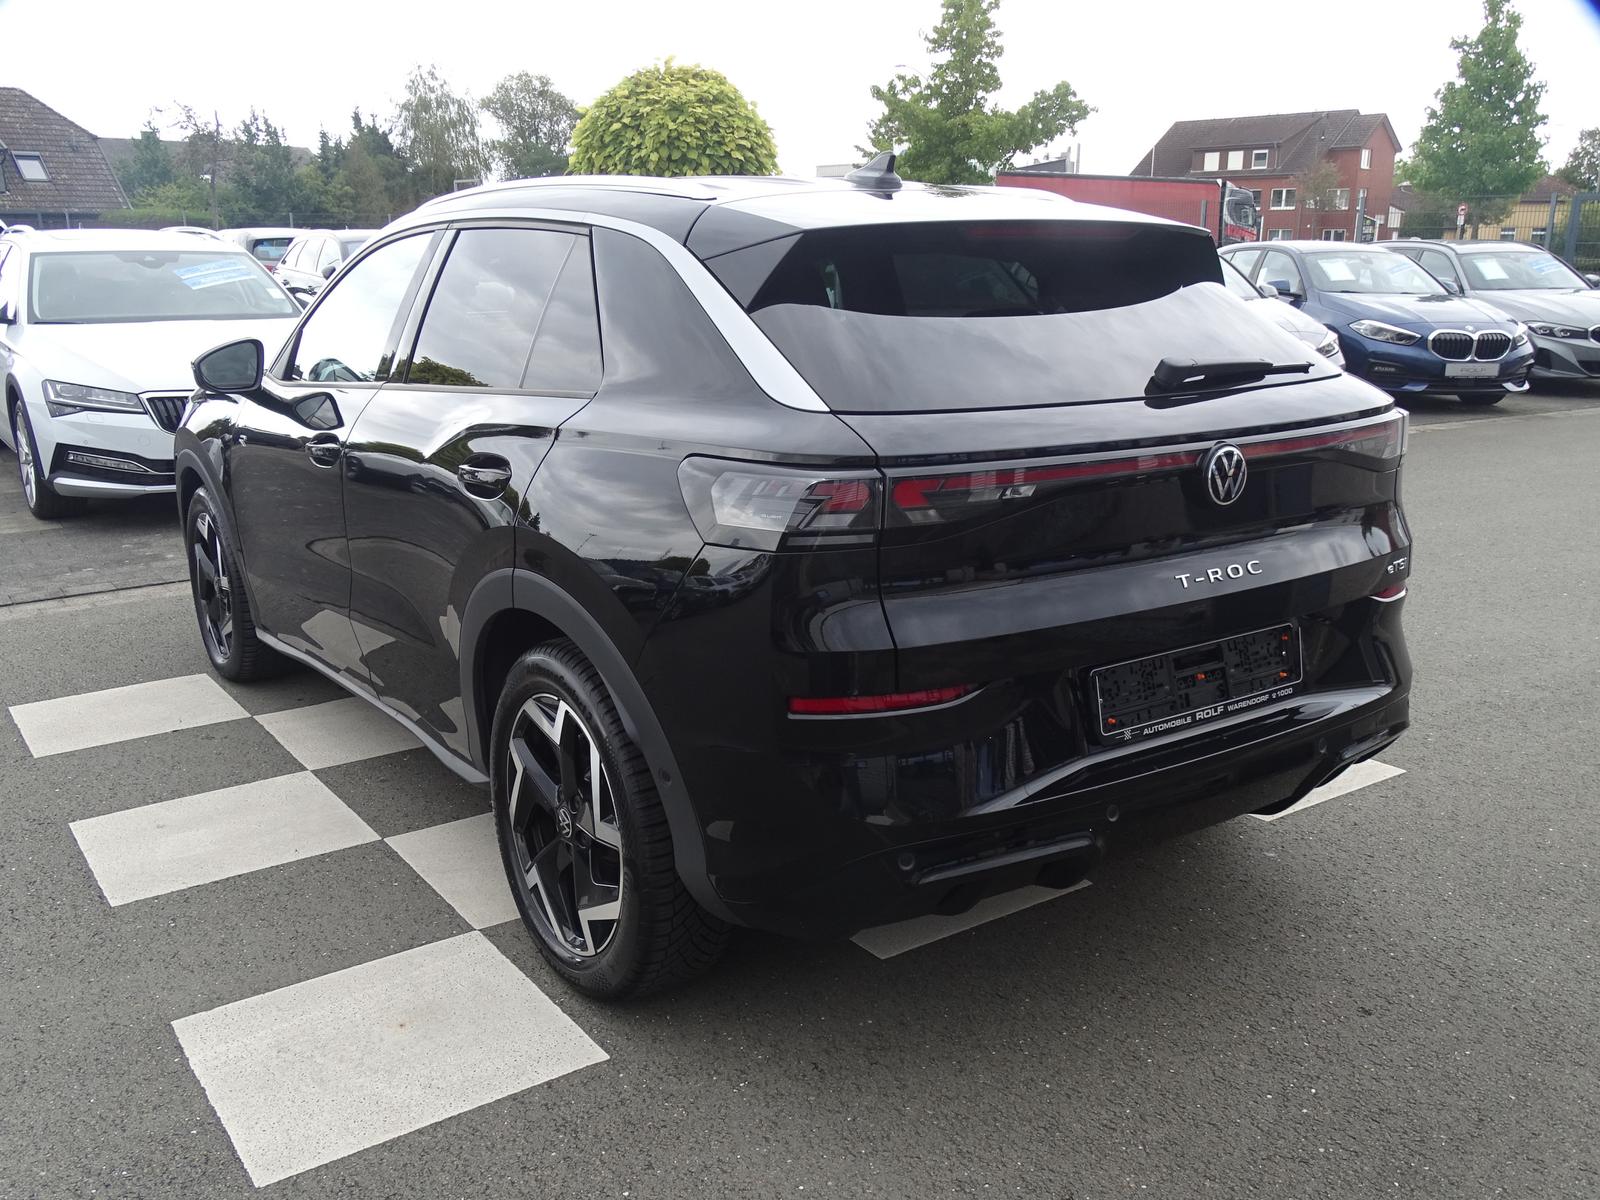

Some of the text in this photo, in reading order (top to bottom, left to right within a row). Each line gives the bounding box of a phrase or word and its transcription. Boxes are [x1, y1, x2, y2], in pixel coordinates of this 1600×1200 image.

[1174, 560, 1262, 589] T-ROC
[1143, 716, 1192, 735] AUTOMOBILE
[1195, 705, 1224, 720] ROLF
[1227, 694, 1270, 712] WARENDORF
